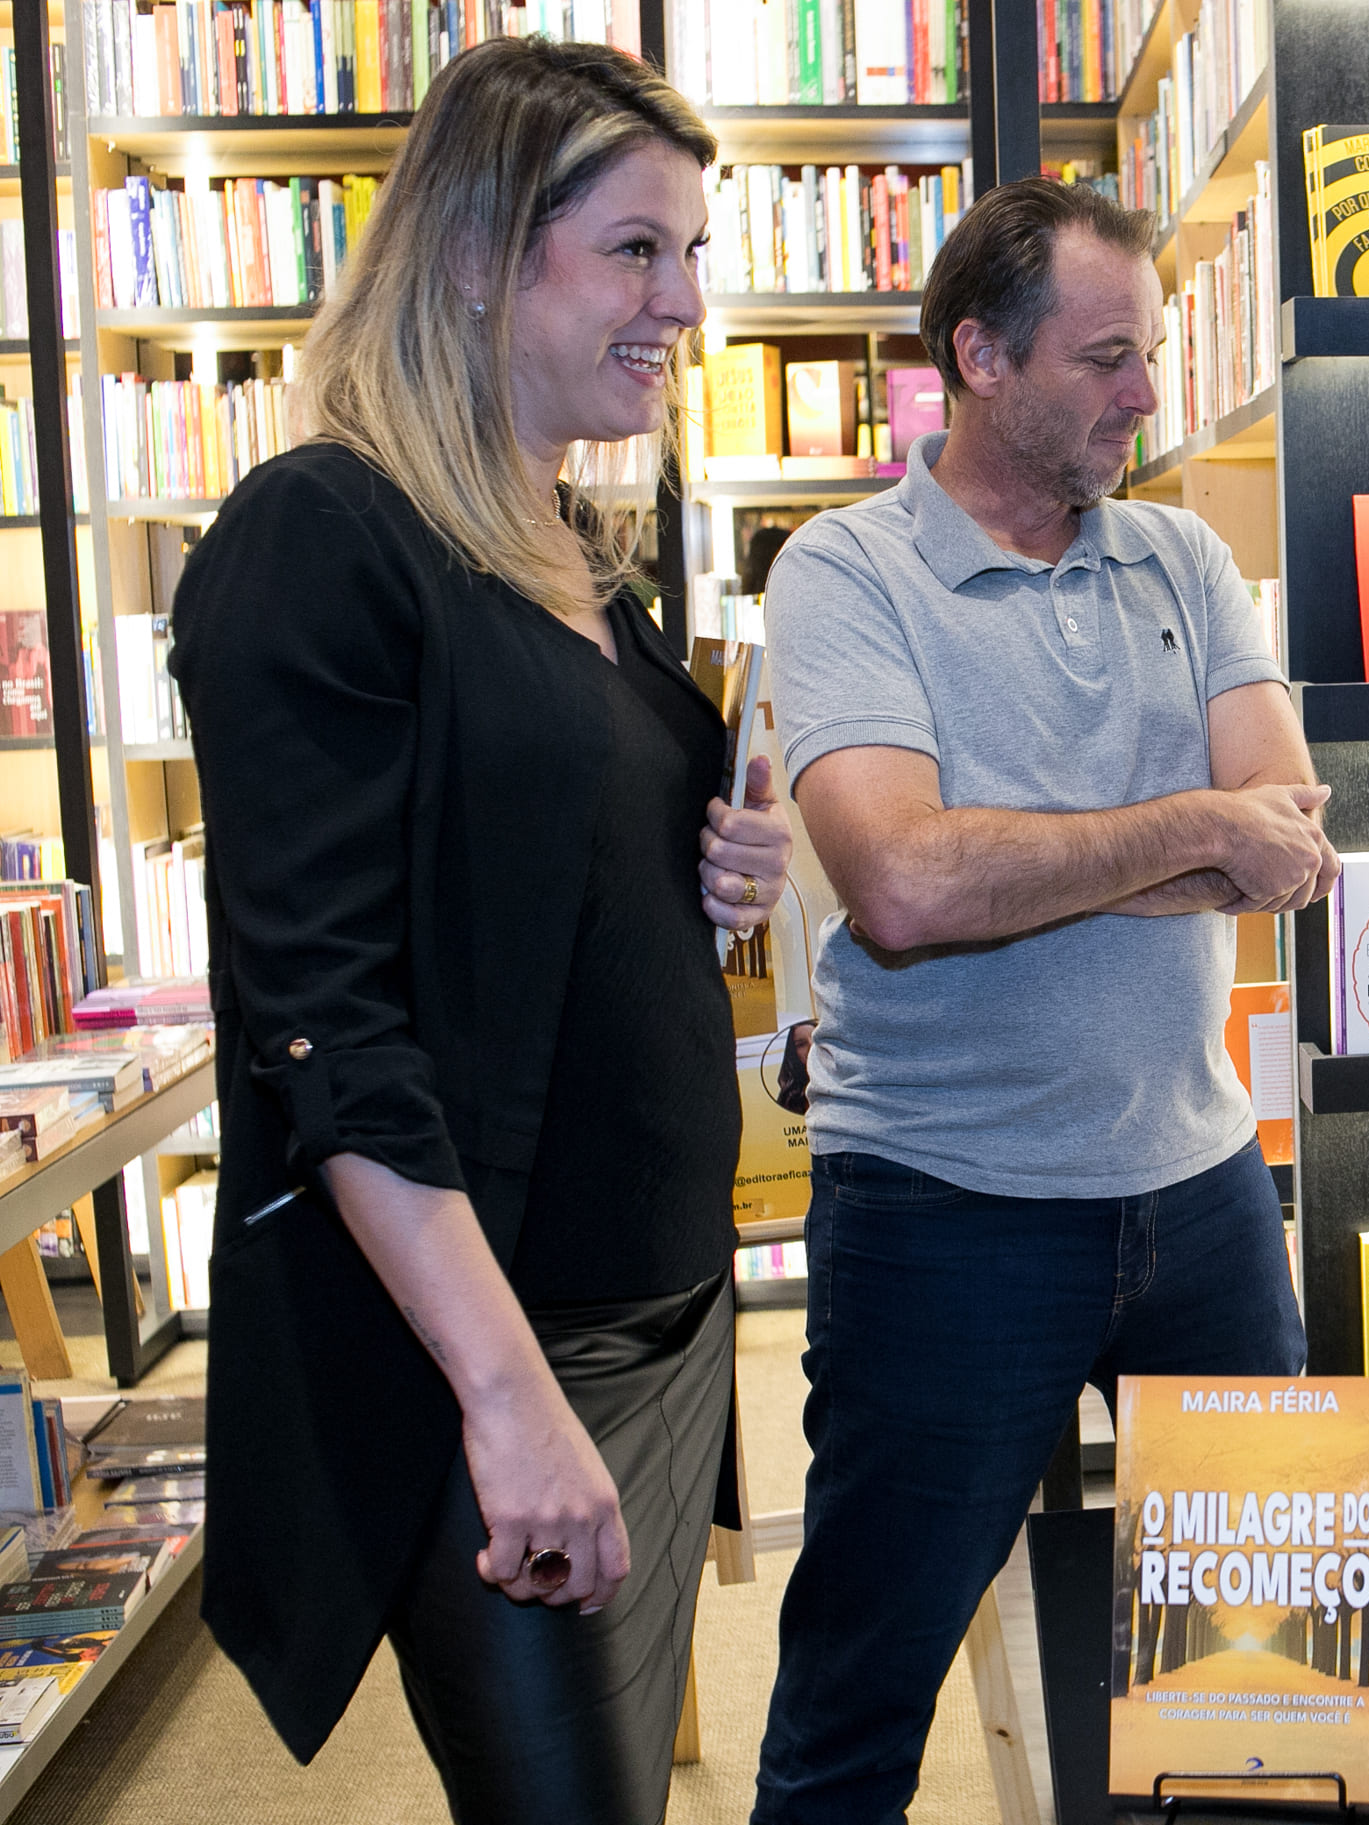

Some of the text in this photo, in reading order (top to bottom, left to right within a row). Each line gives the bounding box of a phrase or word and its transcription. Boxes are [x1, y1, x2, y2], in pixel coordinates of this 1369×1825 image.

[1331, 197, 1359, 221] POR
[1181, 1385, 1340, 1414] MAIRA FÉRIA
[1142, 1490, 1165, 1537] O
[1172, 1490, 1336, 1547] MILAGRE
[1146, 1691, 1365, 1707] LIBERTE-SE DO PASSADO E ENCONTRE A
[1159, 1708, 1351, 1724] CORAGEM PARA SER QUEM VOCÊ É
